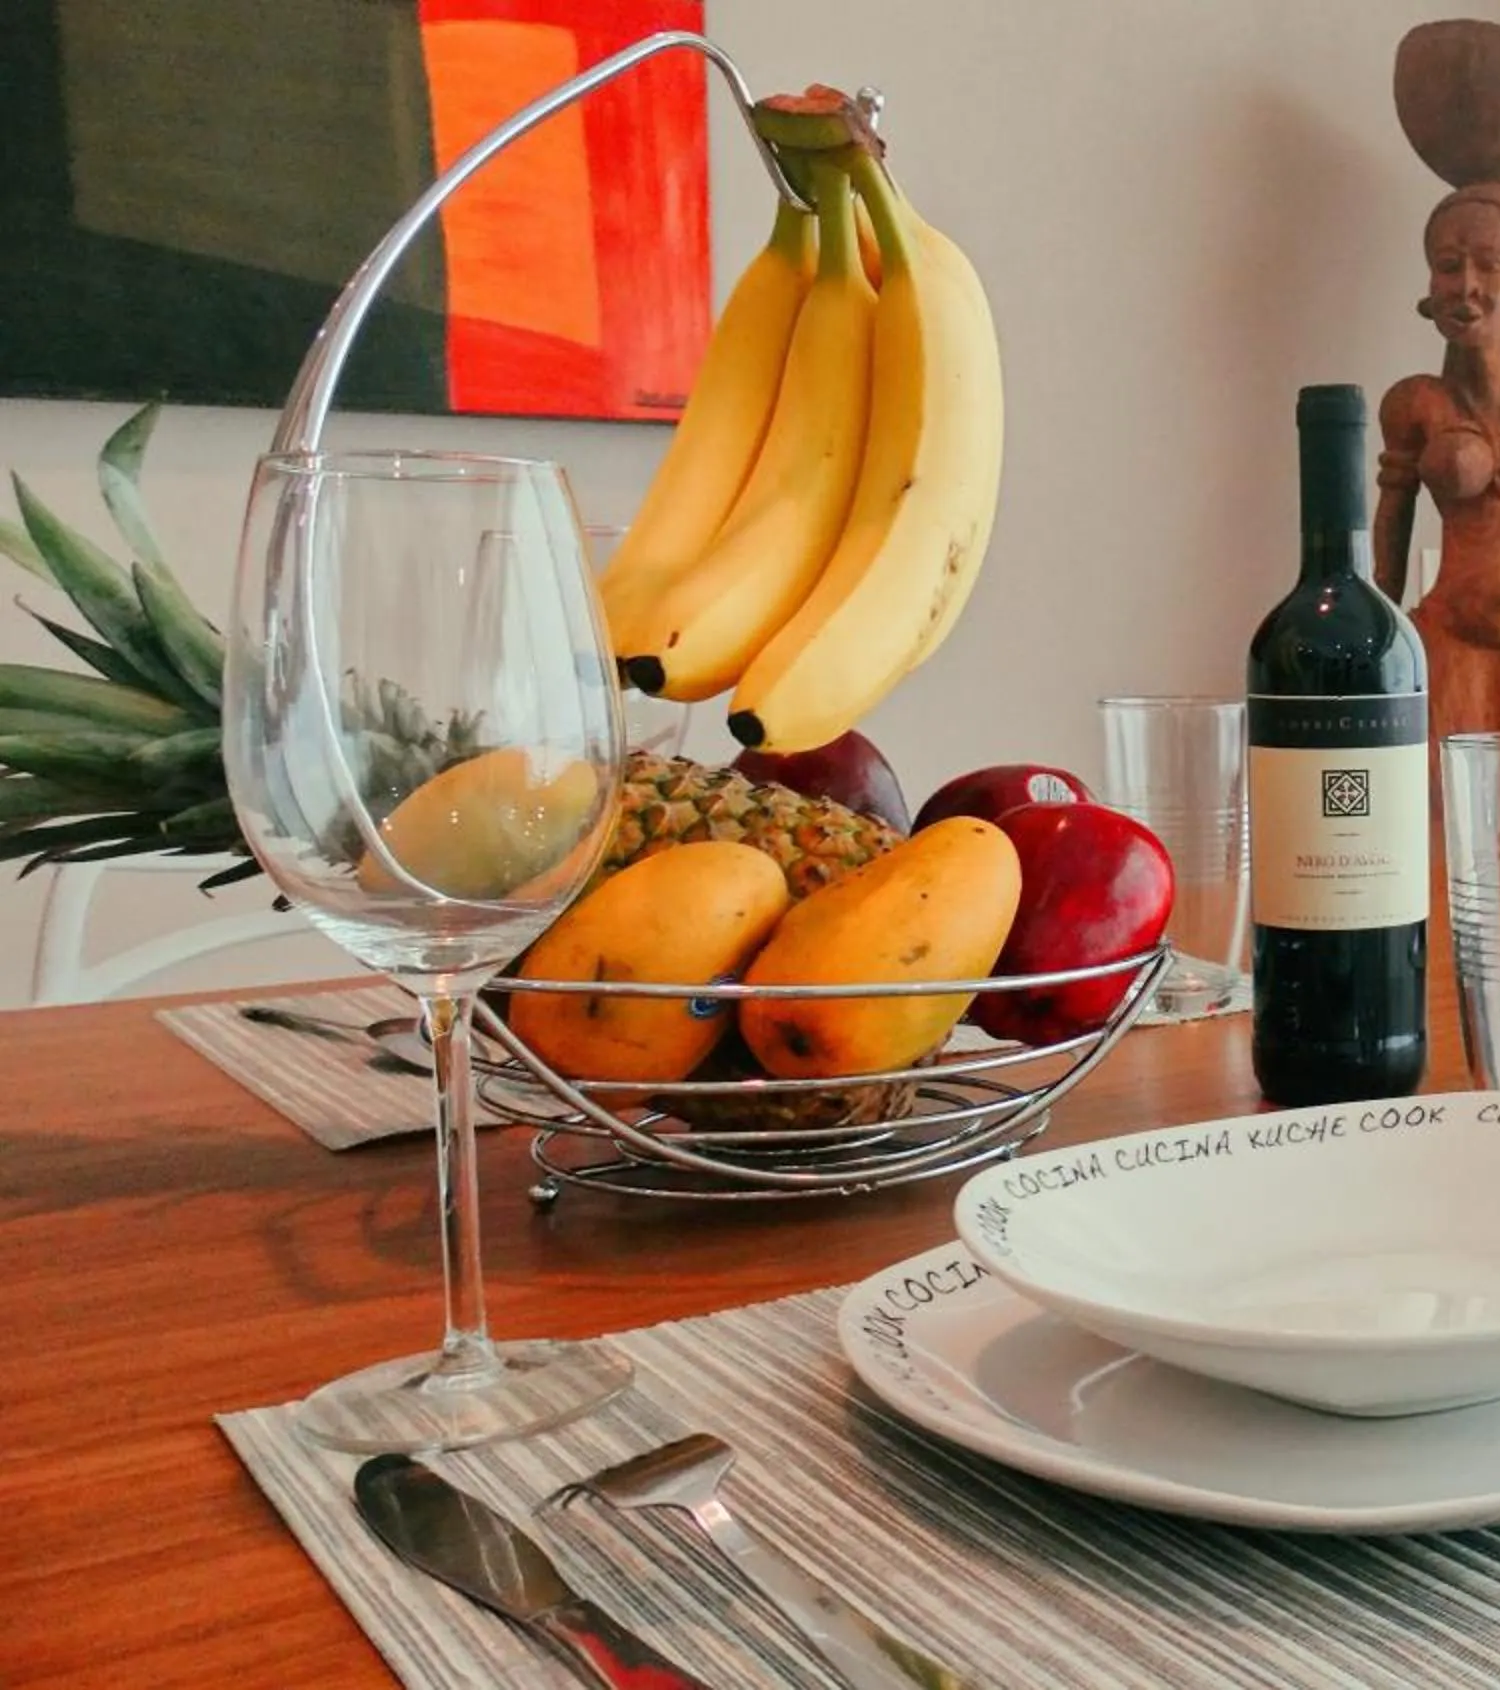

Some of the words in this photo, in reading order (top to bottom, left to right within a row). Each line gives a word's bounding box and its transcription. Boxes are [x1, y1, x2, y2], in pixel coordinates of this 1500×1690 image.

[1004, 1153, 1107, 1200] COCINA
[1115, 1130, 1233, 1171] CUCINA
[1247, 1116, 1347, 1150] KUCHE
[1360, 1105, 1446, 1132] COOK
[885, 1260, 992, 1312] COCIN
